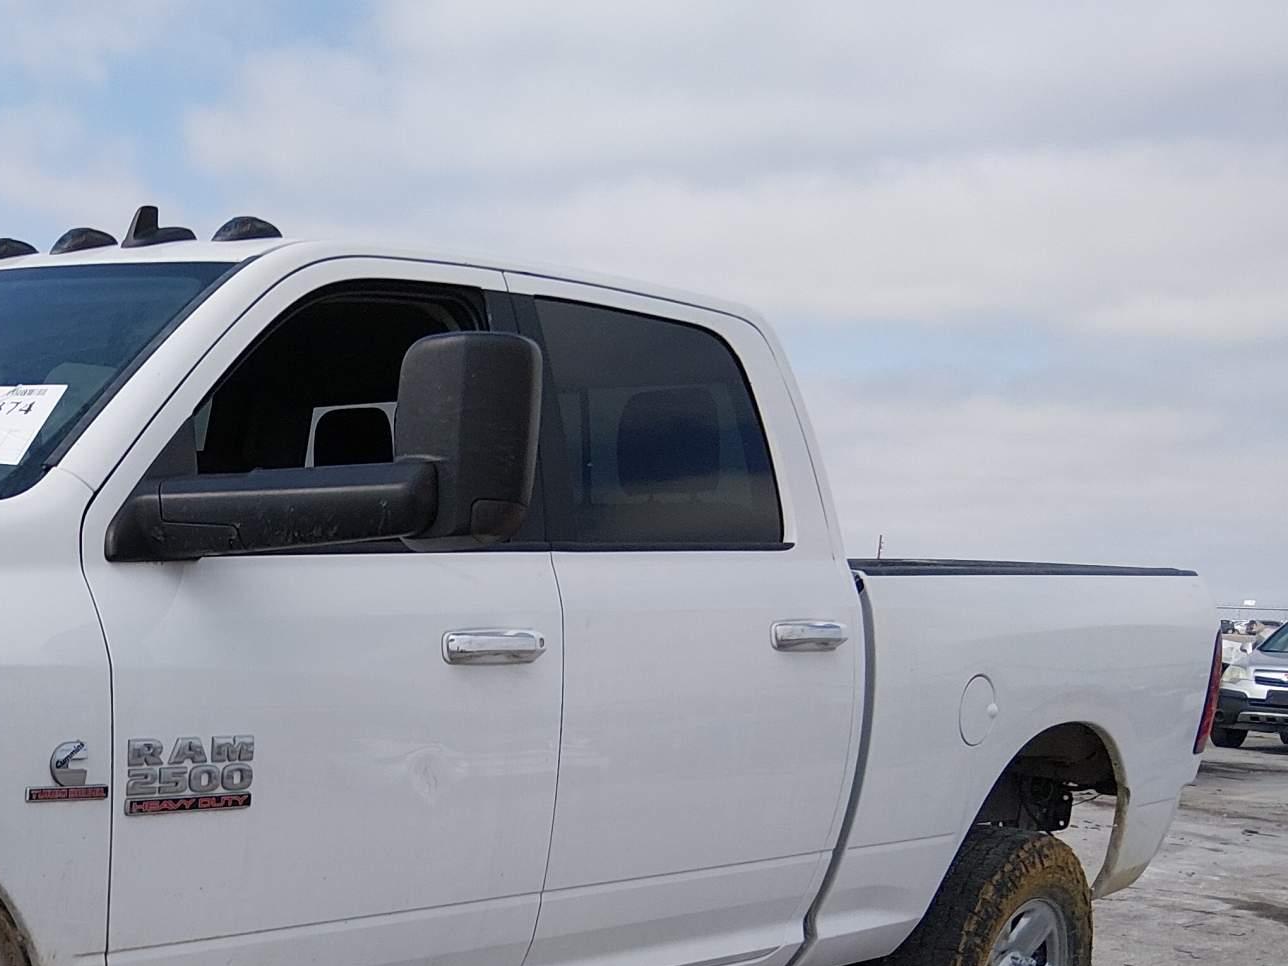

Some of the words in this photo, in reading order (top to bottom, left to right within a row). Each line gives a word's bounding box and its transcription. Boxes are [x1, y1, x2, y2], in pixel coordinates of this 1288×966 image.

[127, 735, 255, 767] RAM
[125, 764, 254, 797] 2500
[132, 799, 196, 813] HEAVY
[198, 795, 249, 810] DUTY
